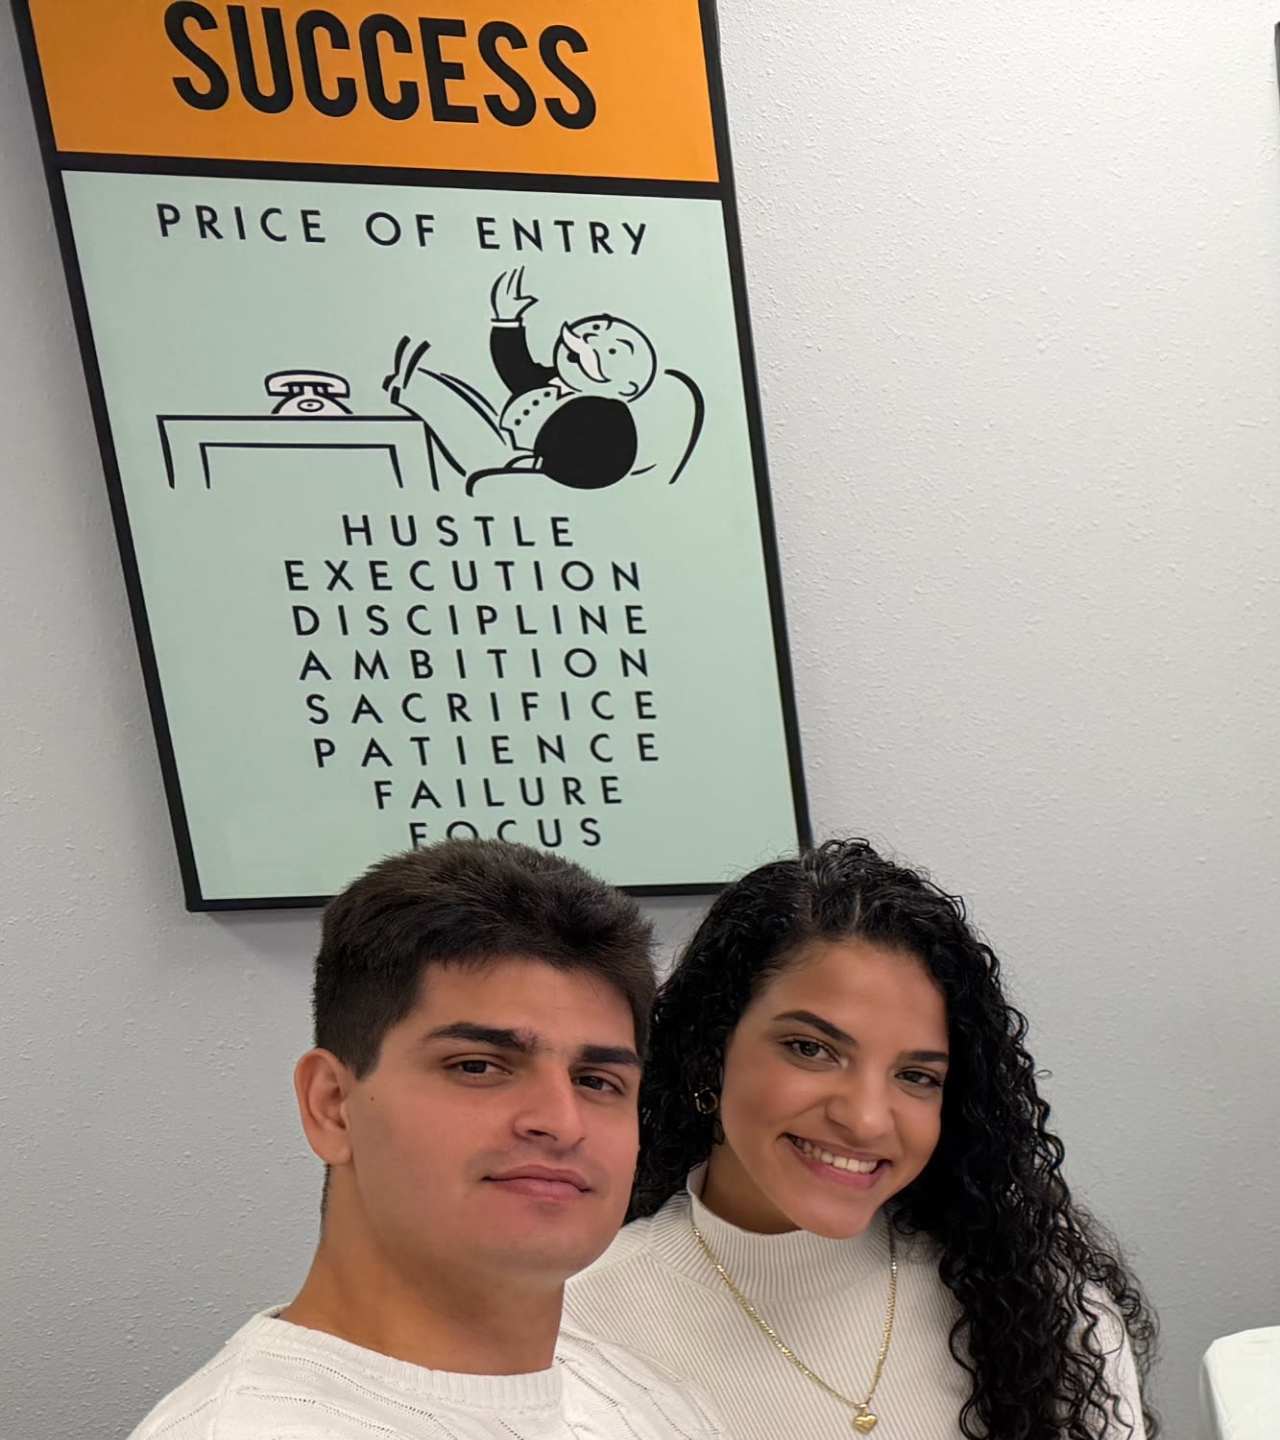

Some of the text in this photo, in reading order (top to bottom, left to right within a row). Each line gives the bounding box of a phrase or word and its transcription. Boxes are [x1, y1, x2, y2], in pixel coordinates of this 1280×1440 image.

[163, 0, 598, 130] SUCCESS
[156, 203, 648, 256] PRICE OF ENTRY
[342, 514, 574, 547] HUSTLE
[284, 559, 641, 592] EXECUTION
[292, 604, 648, 636] DISCIPLINE
[299, 648, 648, 681] AMBITION
[306, 690, 658, 725] SACRIFICE
[313, 733, 660, 768] PATIENCE
[374, 776, 623, 810] FAILURE
[409, 817, 602, 848] FOCUS
